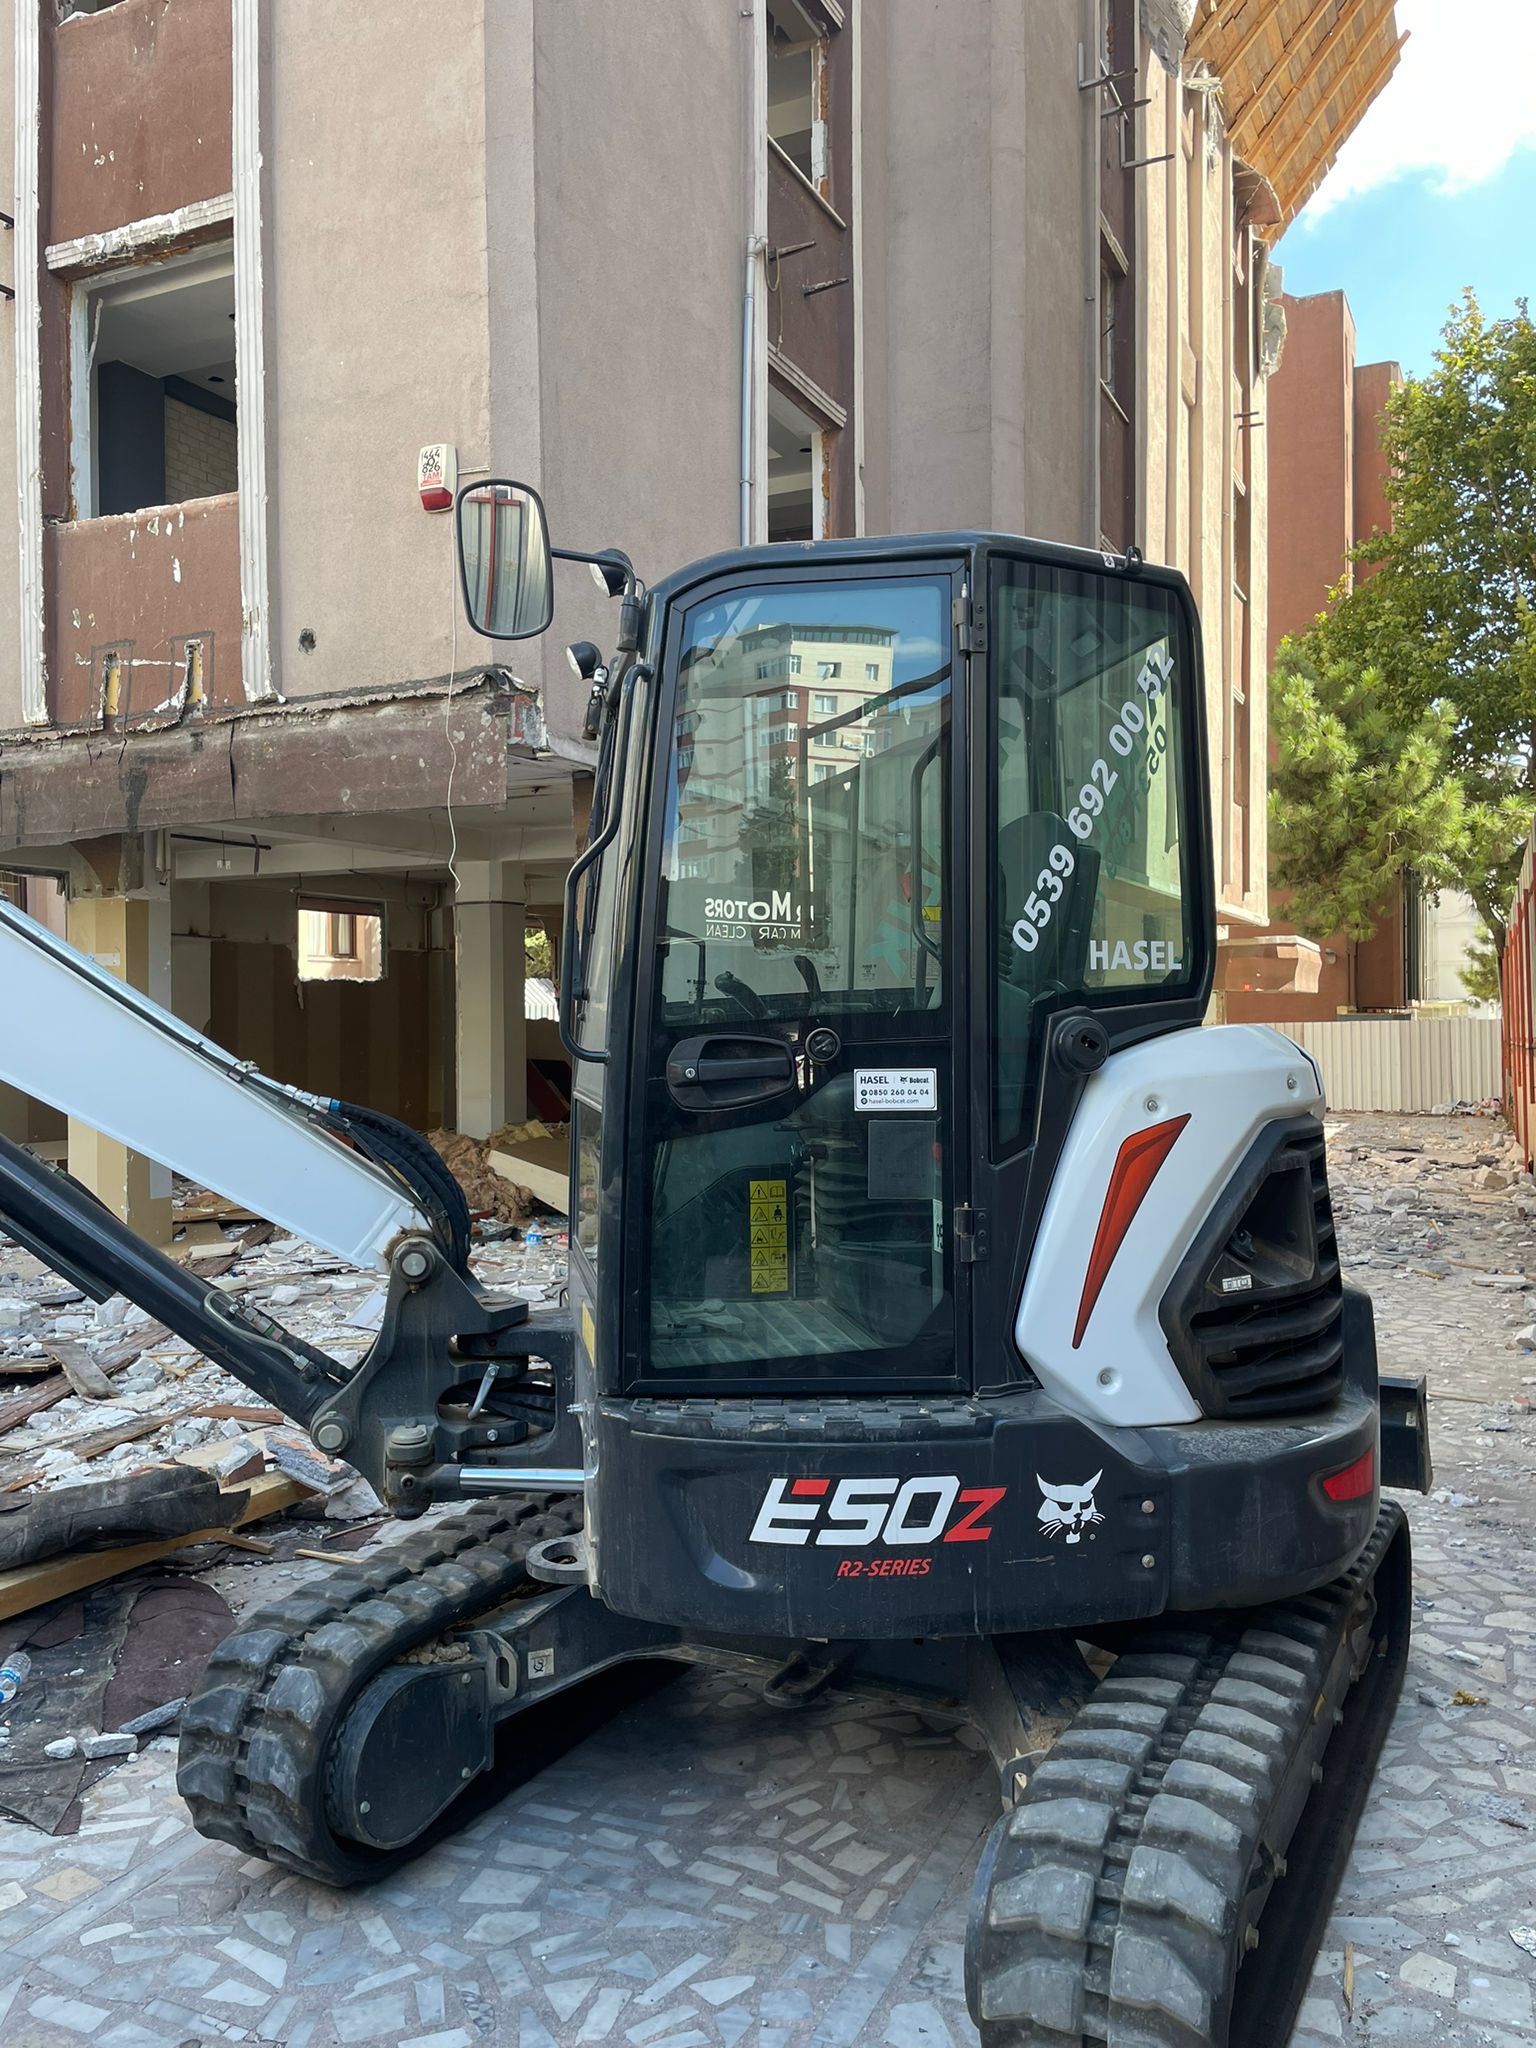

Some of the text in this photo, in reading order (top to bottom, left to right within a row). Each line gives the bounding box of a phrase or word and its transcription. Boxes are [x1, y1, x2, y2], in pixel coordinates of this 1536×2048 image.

[423, 449, 440, 459] 444
[422, 461, 440, 473] 826
[1012, 643, 1175, 952] 0539 692 00 52
[1090, 939, 1182, 971] HASEL
[860, 1076, 889, 1084] HASEL
[837, 1558, 932, 1577] R2-SERIES
